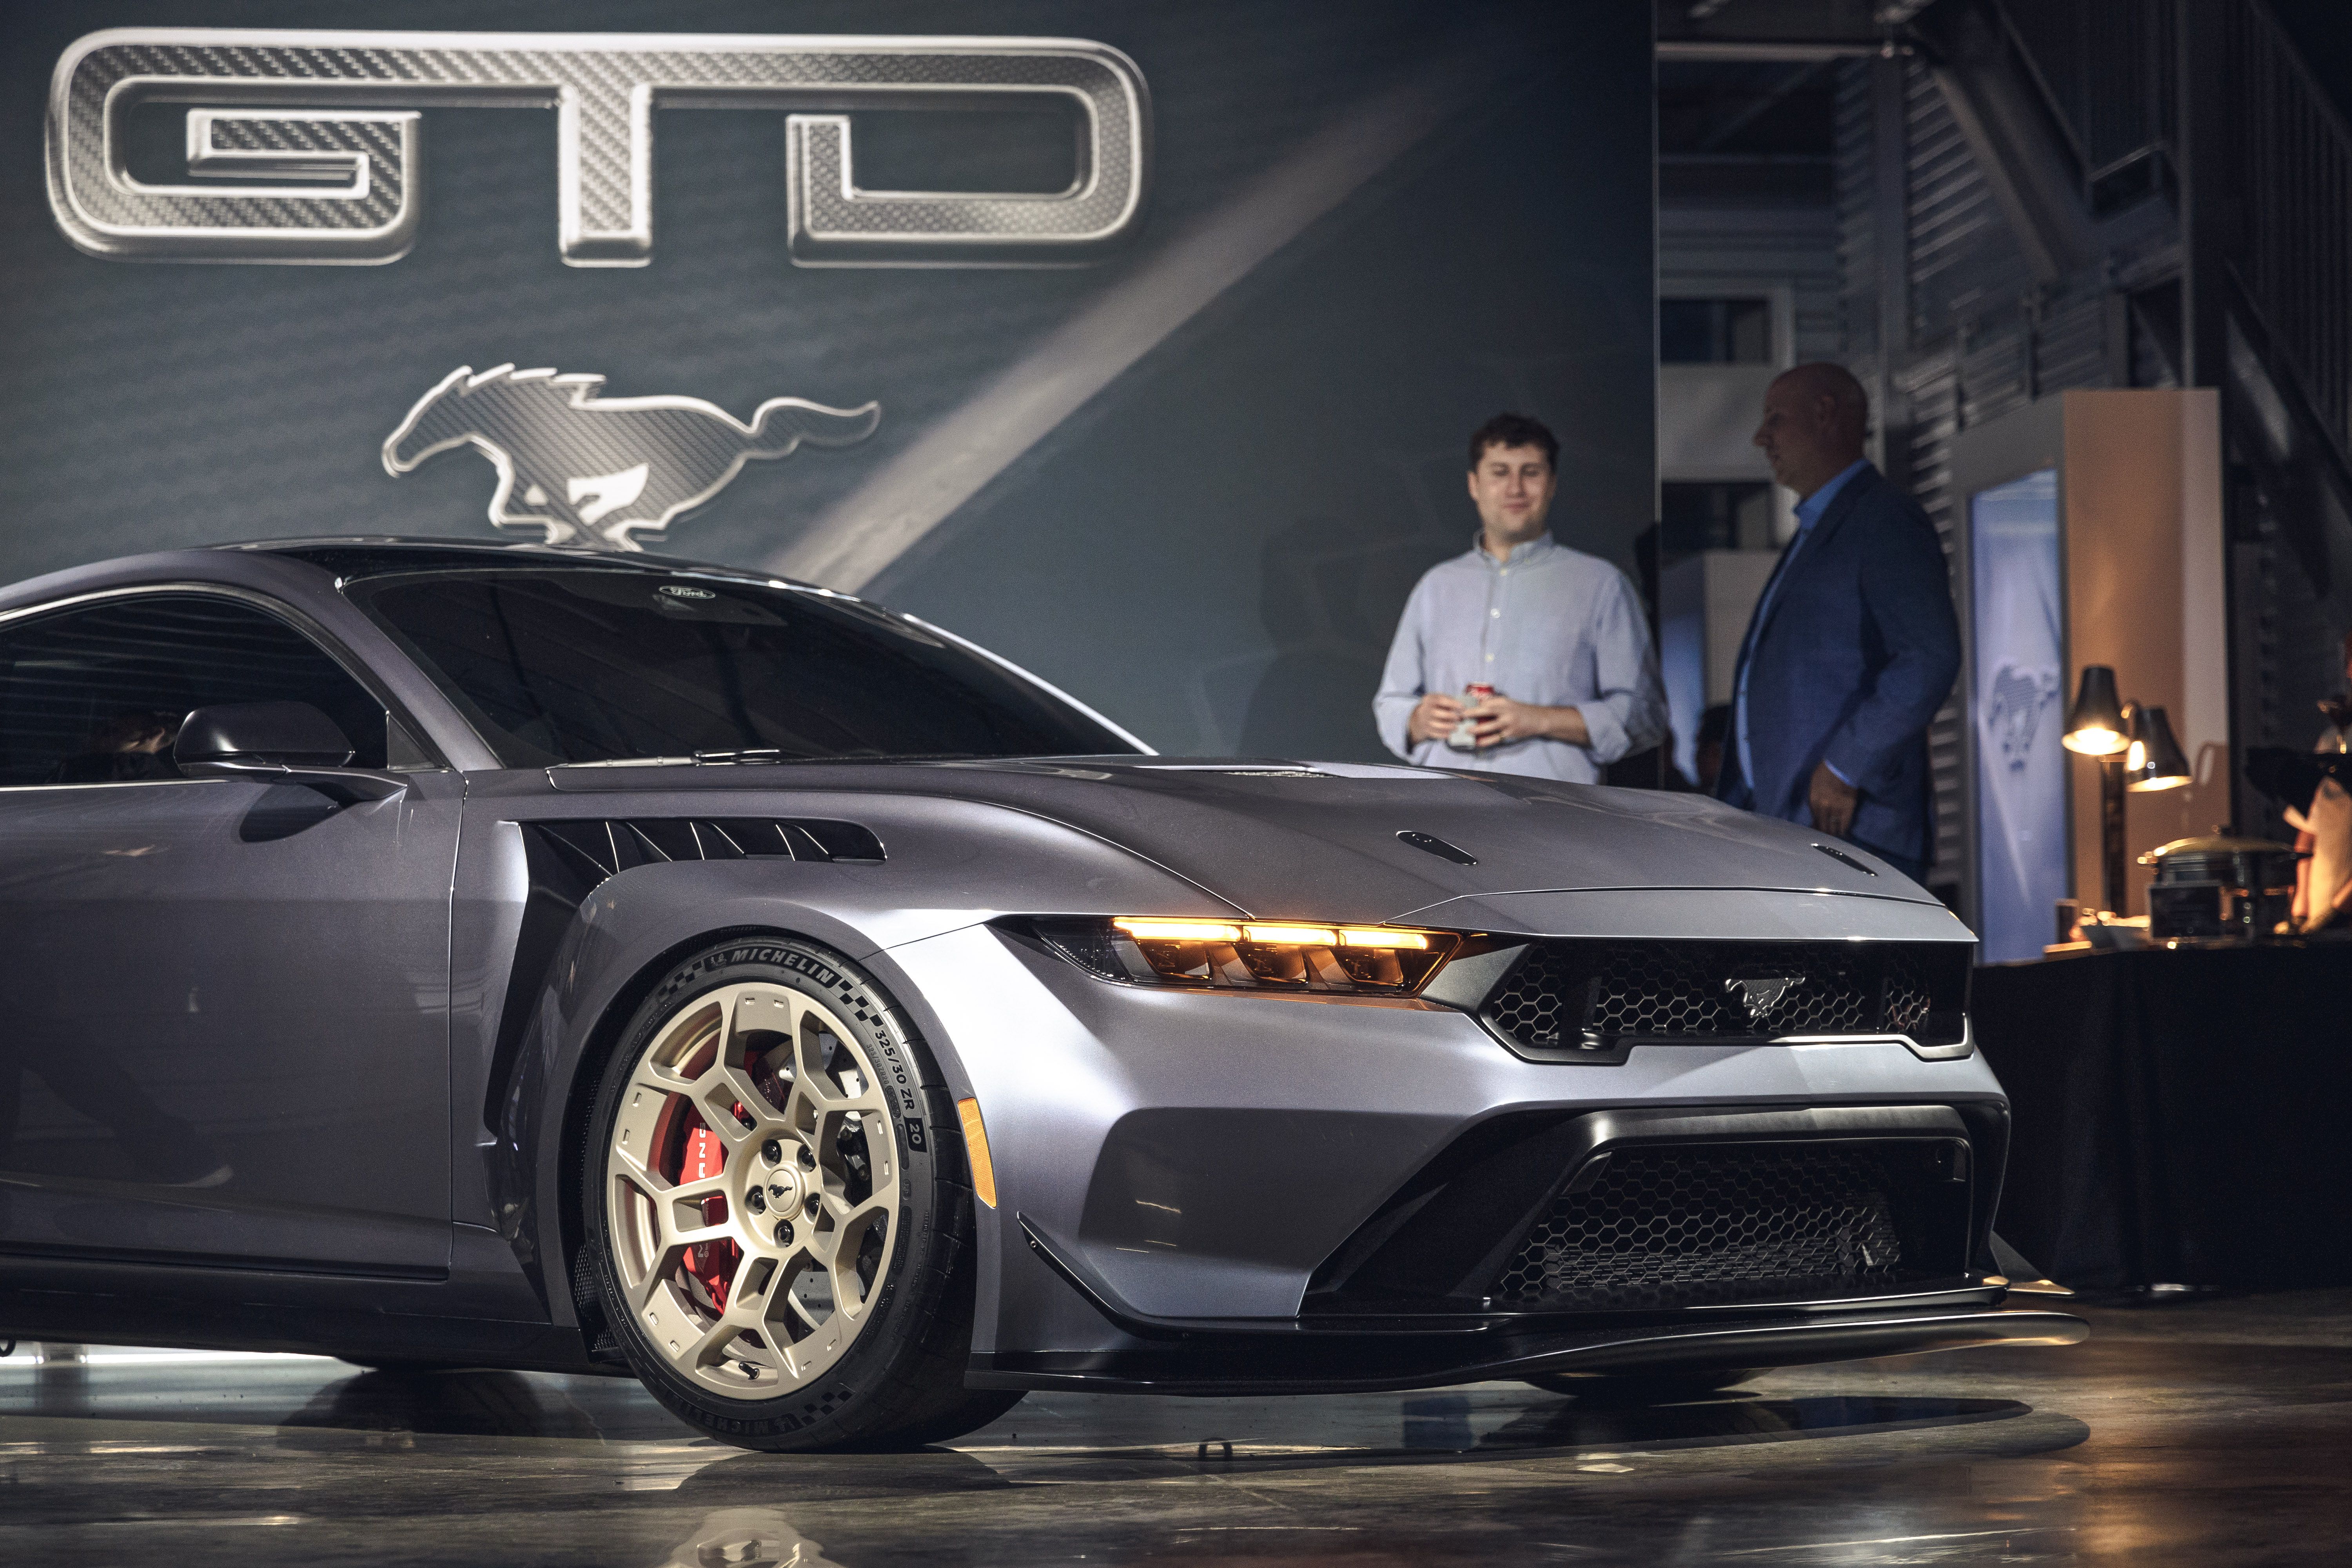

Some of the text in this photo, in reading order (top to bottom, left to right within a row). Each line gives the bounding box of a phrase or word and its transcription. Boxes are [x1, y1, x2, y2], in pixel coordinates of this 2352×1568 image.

[45, 27, 1150, 267] GTD
[670, 587, 707, 597] Ford
[731, 948, 835, 984] MICHELIN
[875, 1030, 907, 1085] 325/30
[900, 1088, 915, 1111] ZR
[909, 1123, 922, 1144] 20
